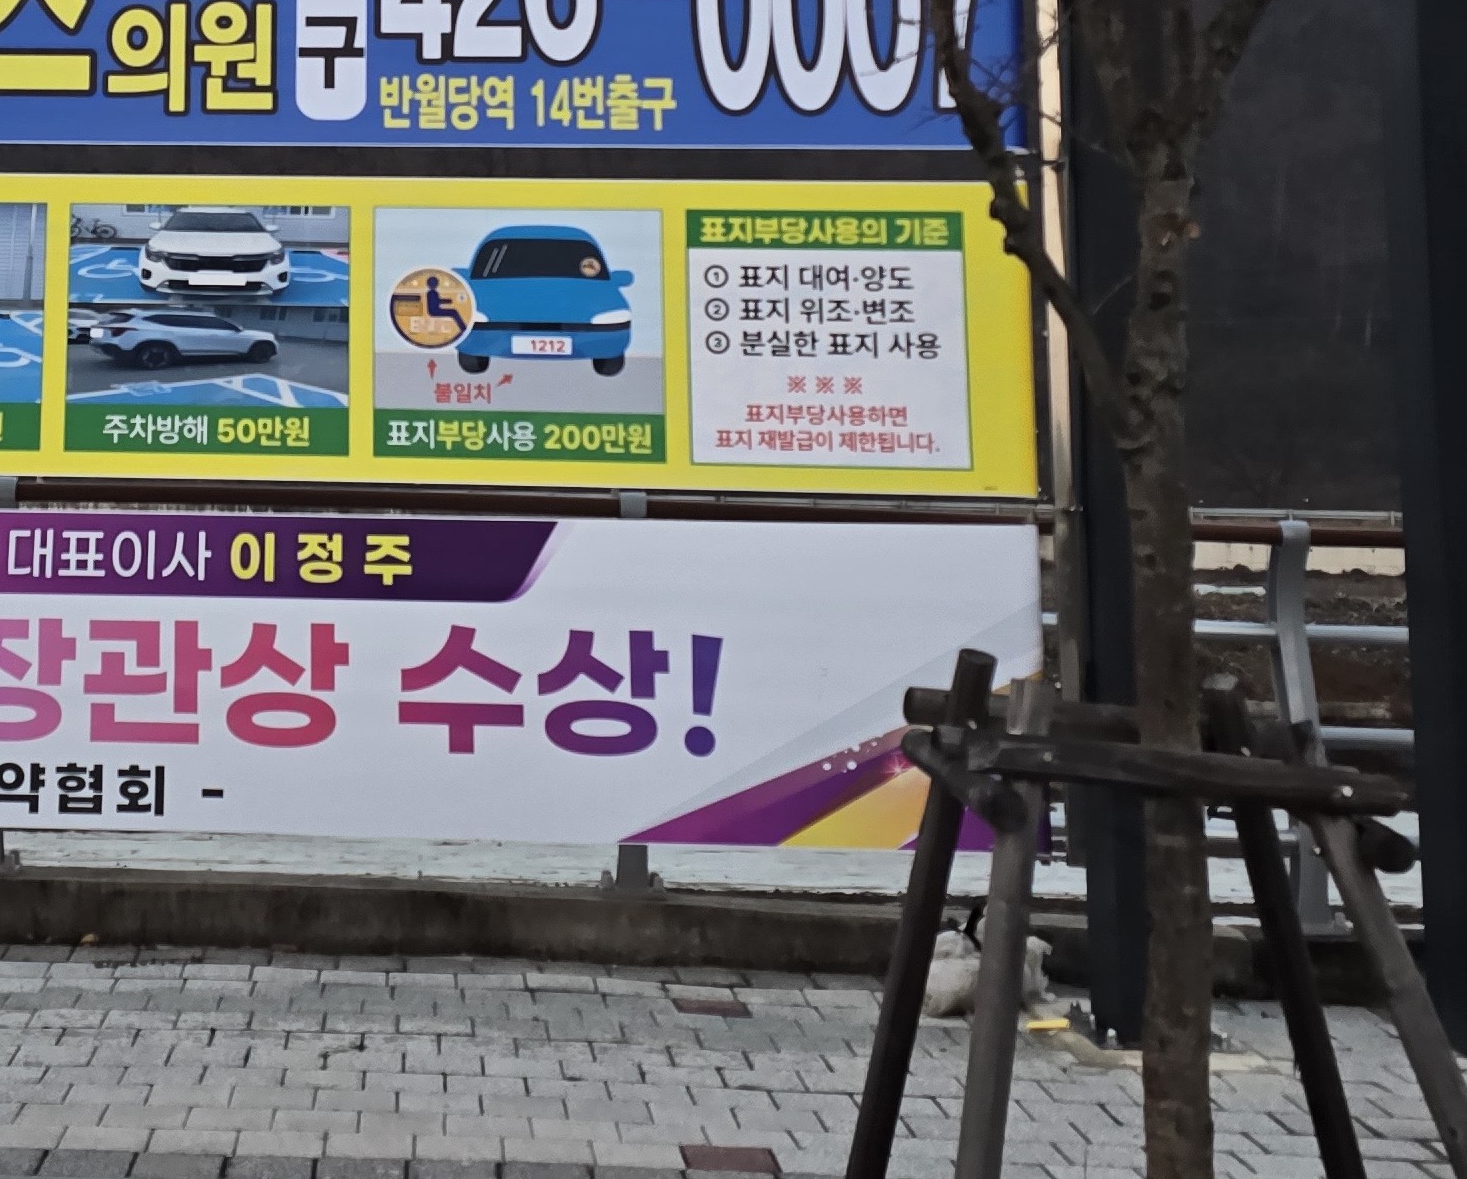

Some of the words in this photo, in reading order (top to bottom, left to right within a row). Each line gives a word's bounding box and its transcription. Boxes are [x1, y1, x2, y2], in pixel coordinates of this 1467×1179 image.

[379, 73, 516, 131] 반월당역
[529, 74, 678, 132] 14번출구
[700, 215, 888, 246] 표지부당사용의
[894, 219, 950, 247] 기준
[738, 264, 791, 291] 표지
[739, 297, 791, 325] 표지
[530, 338, 568, 355] 1212
[739, 330, 819, 358] 분실한
[827, 332, 879, 359] 표지
[888, 333, 943, 360] 사용
[433, 381, 493, 406] 불일치
[745, 403, 909, 427] 표지부당사용하면
[102, 413, 209, 446] 주차방해
[216, 415, 311, 448] 50만원
[386, 419, 538, 452] 표지부당사용
[543, 422, 653, 455] 200만원
[715, 430, 753, 449] 표지
[757, 430, 835, 453] 재발급이
[839, 430, 941, 454] 제한됩니다.
[7, 529, 213, 583] 대표이사
[397, 624, 725, 758] 수상!
